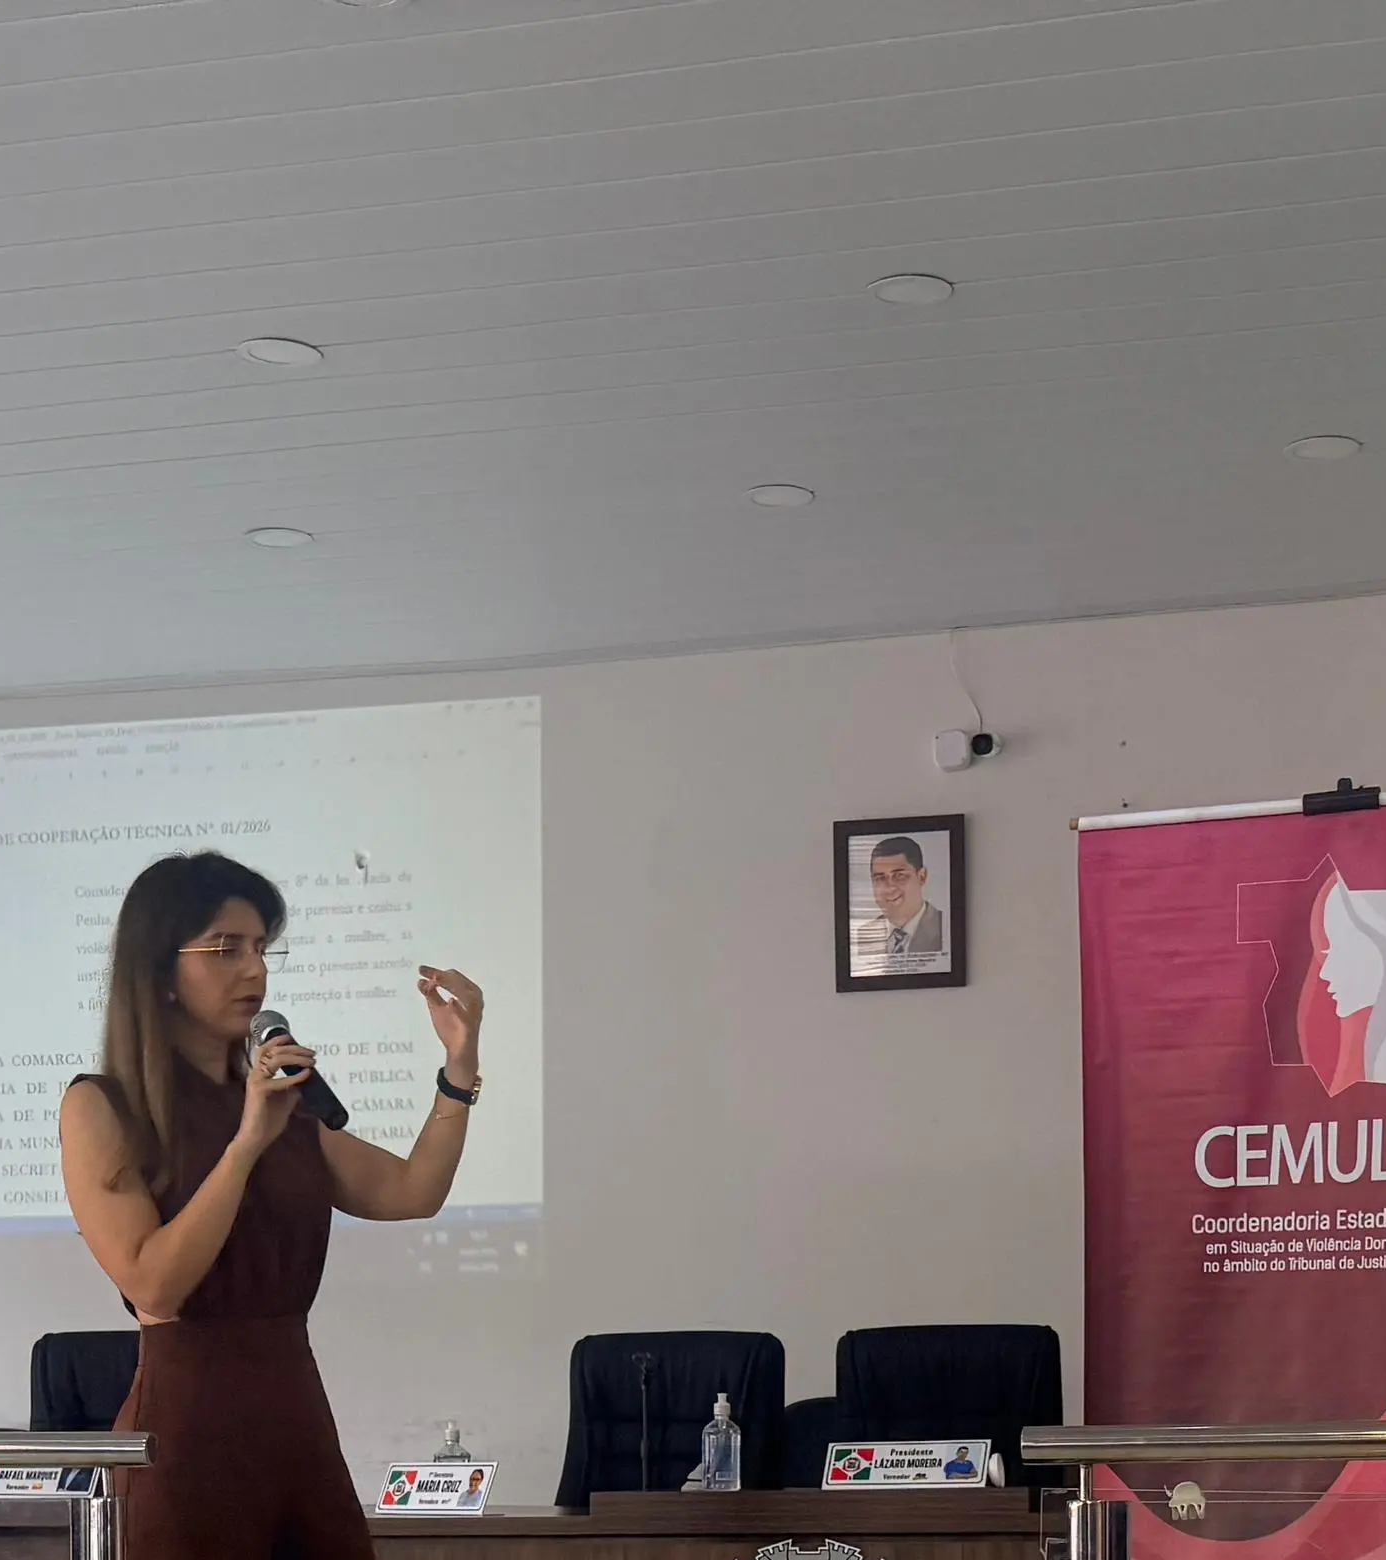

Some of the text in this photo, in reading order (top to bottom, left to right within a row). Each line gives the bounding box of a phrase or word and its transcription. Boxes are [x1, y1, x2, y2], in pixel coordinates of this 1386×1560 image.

[17, 824, 120, 845] COOPERAÇÃO
[122, 822, 192, 842] TÉCNICA
[221, 819, 271, 835] 01/2026
[348, 1042, 370, 1056] DE
[378, 1041, 414, 1054] DOM
[11, 1053, 84, 1067] COMARCA
[349, 1068, 414, 1084] PÚBLICA
[26, 1081, 48, 1094] DE
[351, 1096, 414, 1112] CÂMARA
[14, 1110, 34, 1122] DE
[19, 1136, 61, 1150] MUNI
[1, 1162, 58, 1176] SECRET
[3, 1189, 66, 1205] CONSEL
[1192, 1210, 1330, 1234] Coordenadoria
[1206, 1243, 1227, 1255] em
[1230, 1240, 1285, 1256] Situação
[1288, 1239, 1303, 1252] de
[1306, 1237, 1361, 1252] Violência
[1204, 1261, 1219, 1273] no
[1223, 1258, 1266, 1273] âmbito
[1270, 1257, 1286, 1271] do
[1289, 1256, 1335, 1271] Tribunal
[1339, 1255, 1354, 1269] de
[890, 1448, 934, 1456] Presidente
[874, 1458, 942, 1469] LÁZARO MOREIRA
[416, 1480, 462, 1493] MARIA CRUZ
